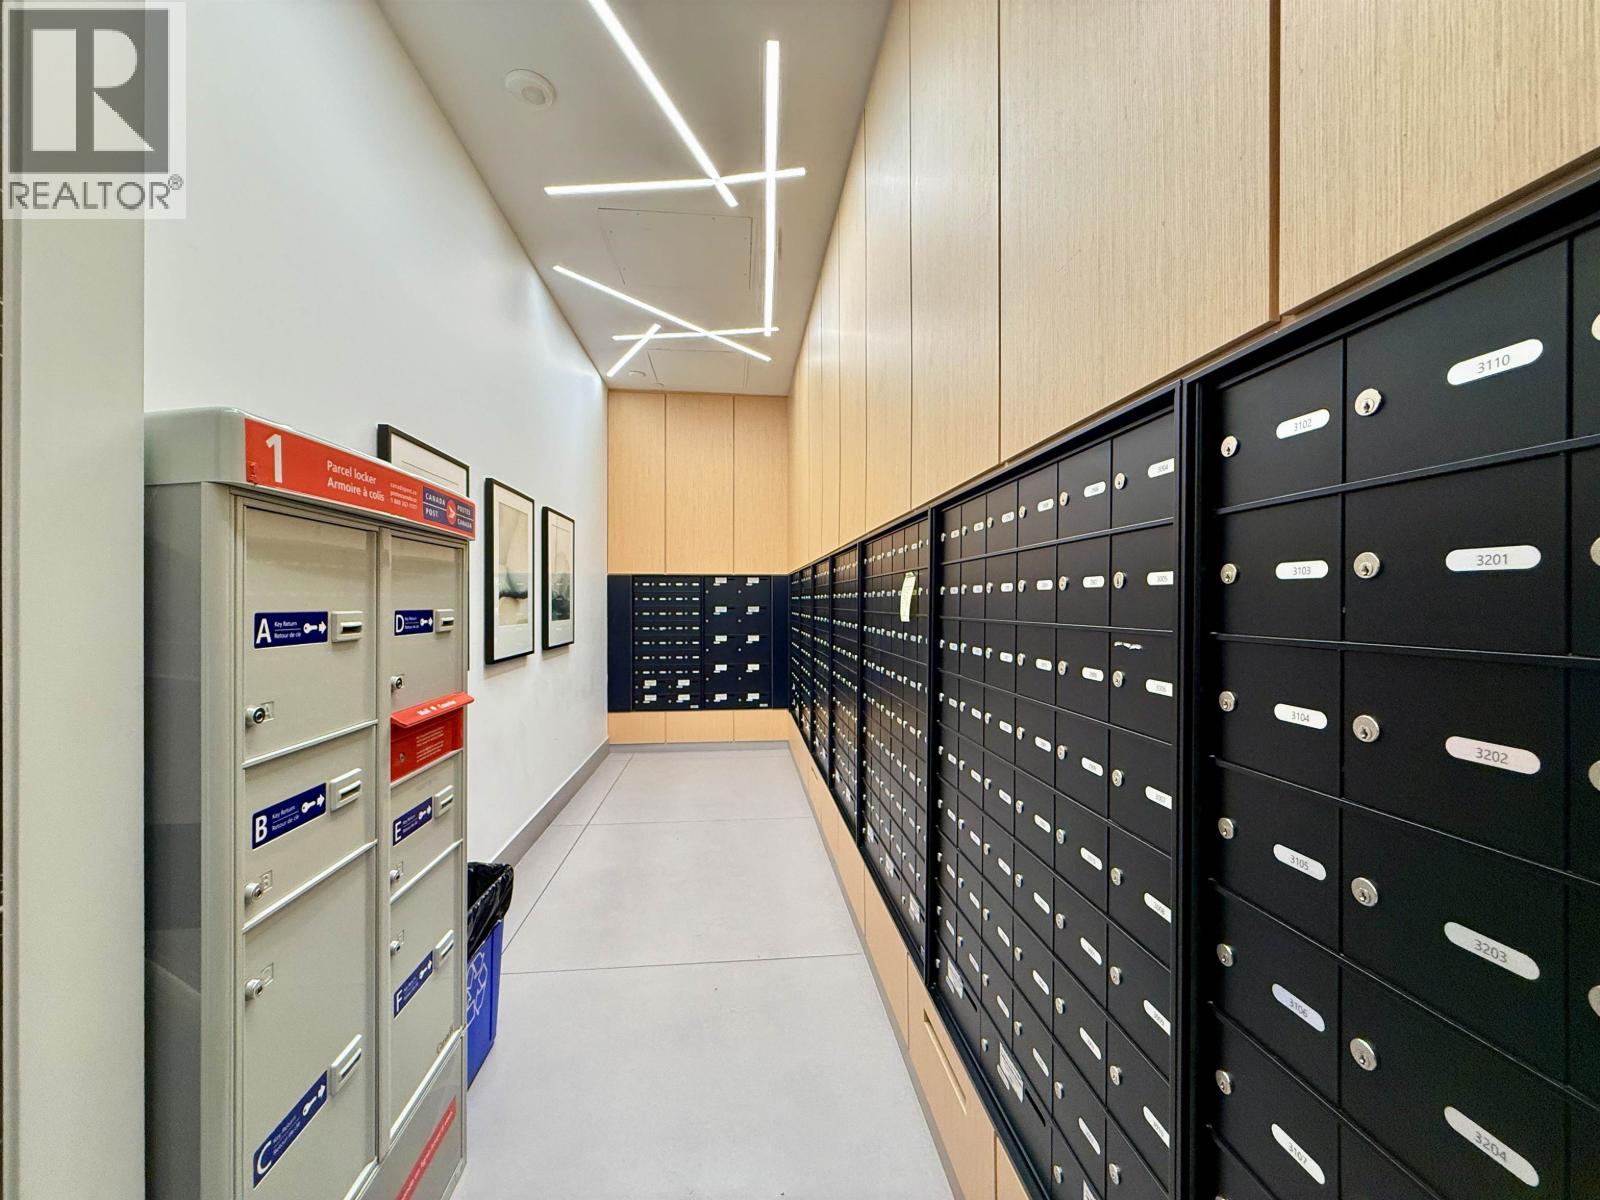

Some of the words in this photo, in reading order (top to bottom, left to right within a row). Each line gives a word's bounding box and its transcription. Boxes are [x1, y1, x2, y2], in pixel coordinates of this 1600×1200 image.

[1477, 354, 1511, 374] 3110
[1293, 418, 1312, 431] 3102
[265, 433, 283, 484] 1
[327, 459, 352, 478] Parcel
[353, 468, 377, 485] locker
[327, 476, 362, 496] Armoire
[362, 486, 368, 497] à
[369, 490, 385, 502] colis
[425, 492, 446, 506] CANADA
[425, 507, 439, 518] POST
[1476, 553, 1508, 566] 3201
[1292, 566, 1311, 576] 3103
[256, 618, 272, 644] A
[396, 614, 405, 633] D
[1291, 711, 1310, 723] 3104
[1475, 747, 1509, 765] 3202
[255, 815, 268, 843] B
[395, 820, 402, 842] E
[1290, 854, 1309, 871] 3105
[1474, 938, 1508, 963] 3203
[396, 989, 403, 1013] F
[1289, 998, 1308, 1018] 3106
[1288, 1142, 1308, 1165] 3107
[1475, 1130, 1508, 1162] 3204
[257, 1140, 272, 1175] C
